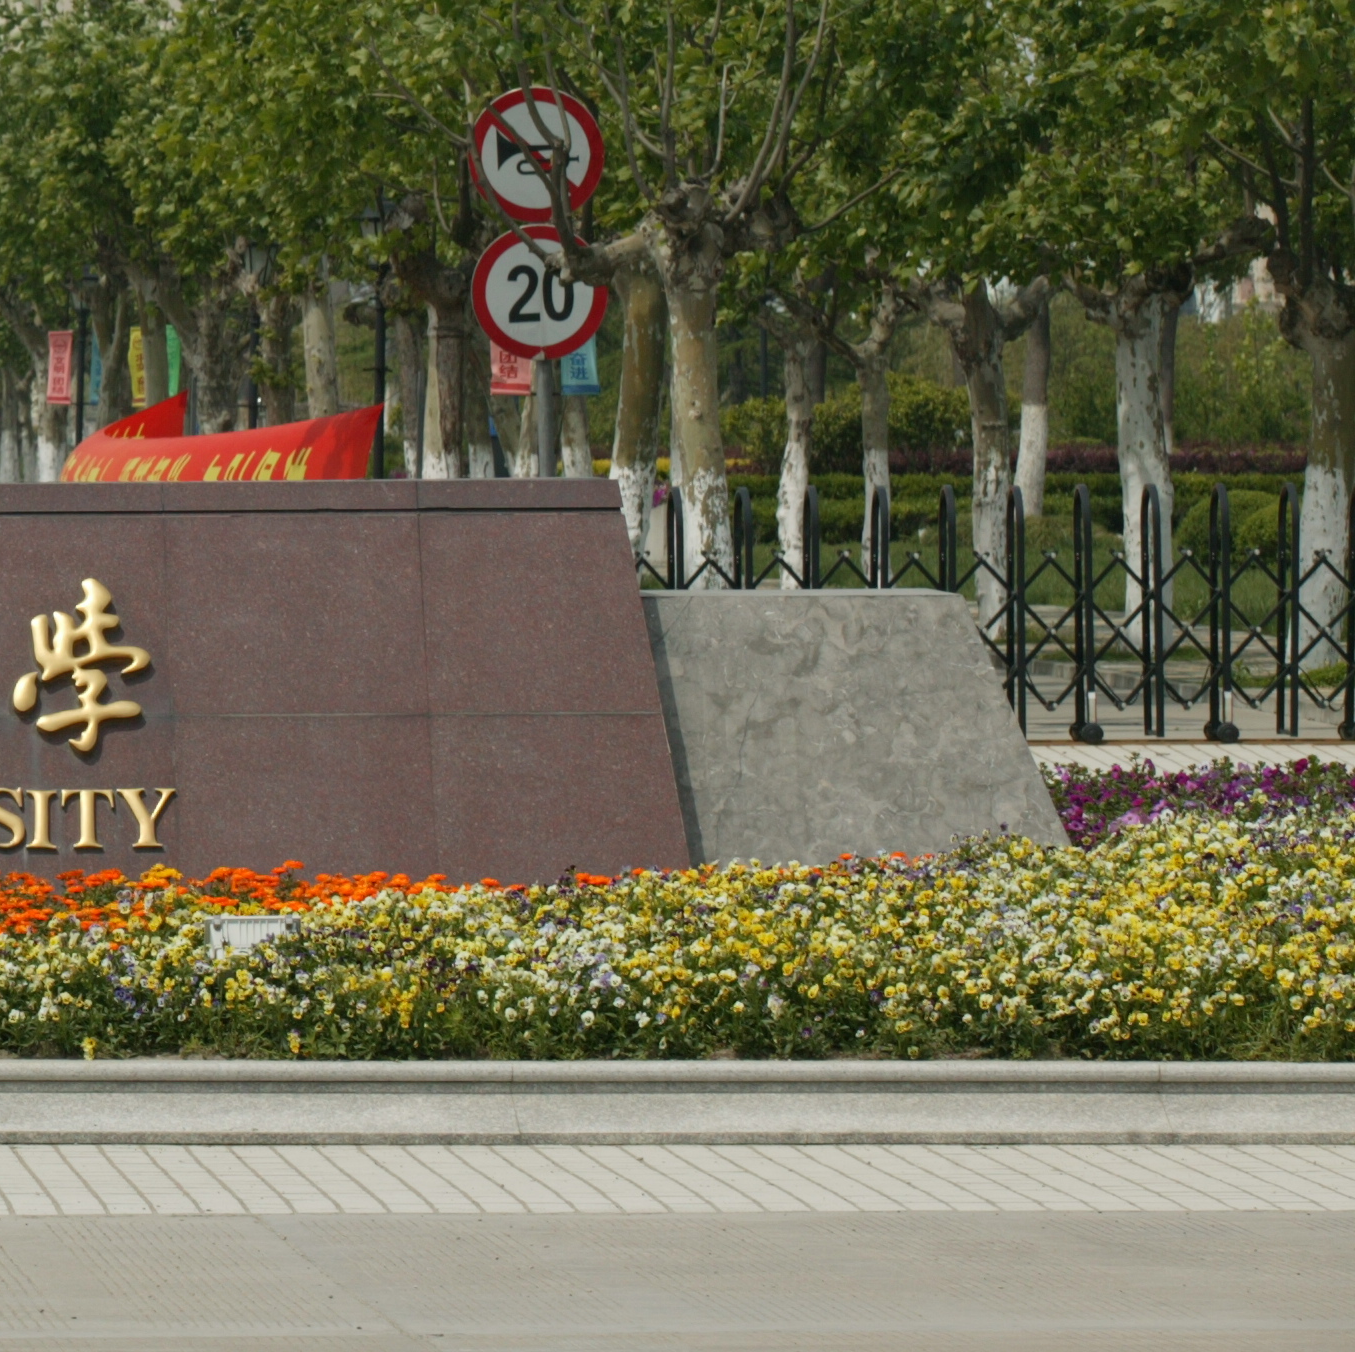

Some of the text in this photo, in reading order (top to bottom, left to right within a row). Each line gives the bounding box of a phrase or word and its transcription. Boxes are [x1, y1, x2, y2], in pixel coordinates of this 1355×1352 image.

[507, 265, 575, 323] 20
[499, 350, 518, 379] 团结
[570, 352, 589, 380] 奋进
